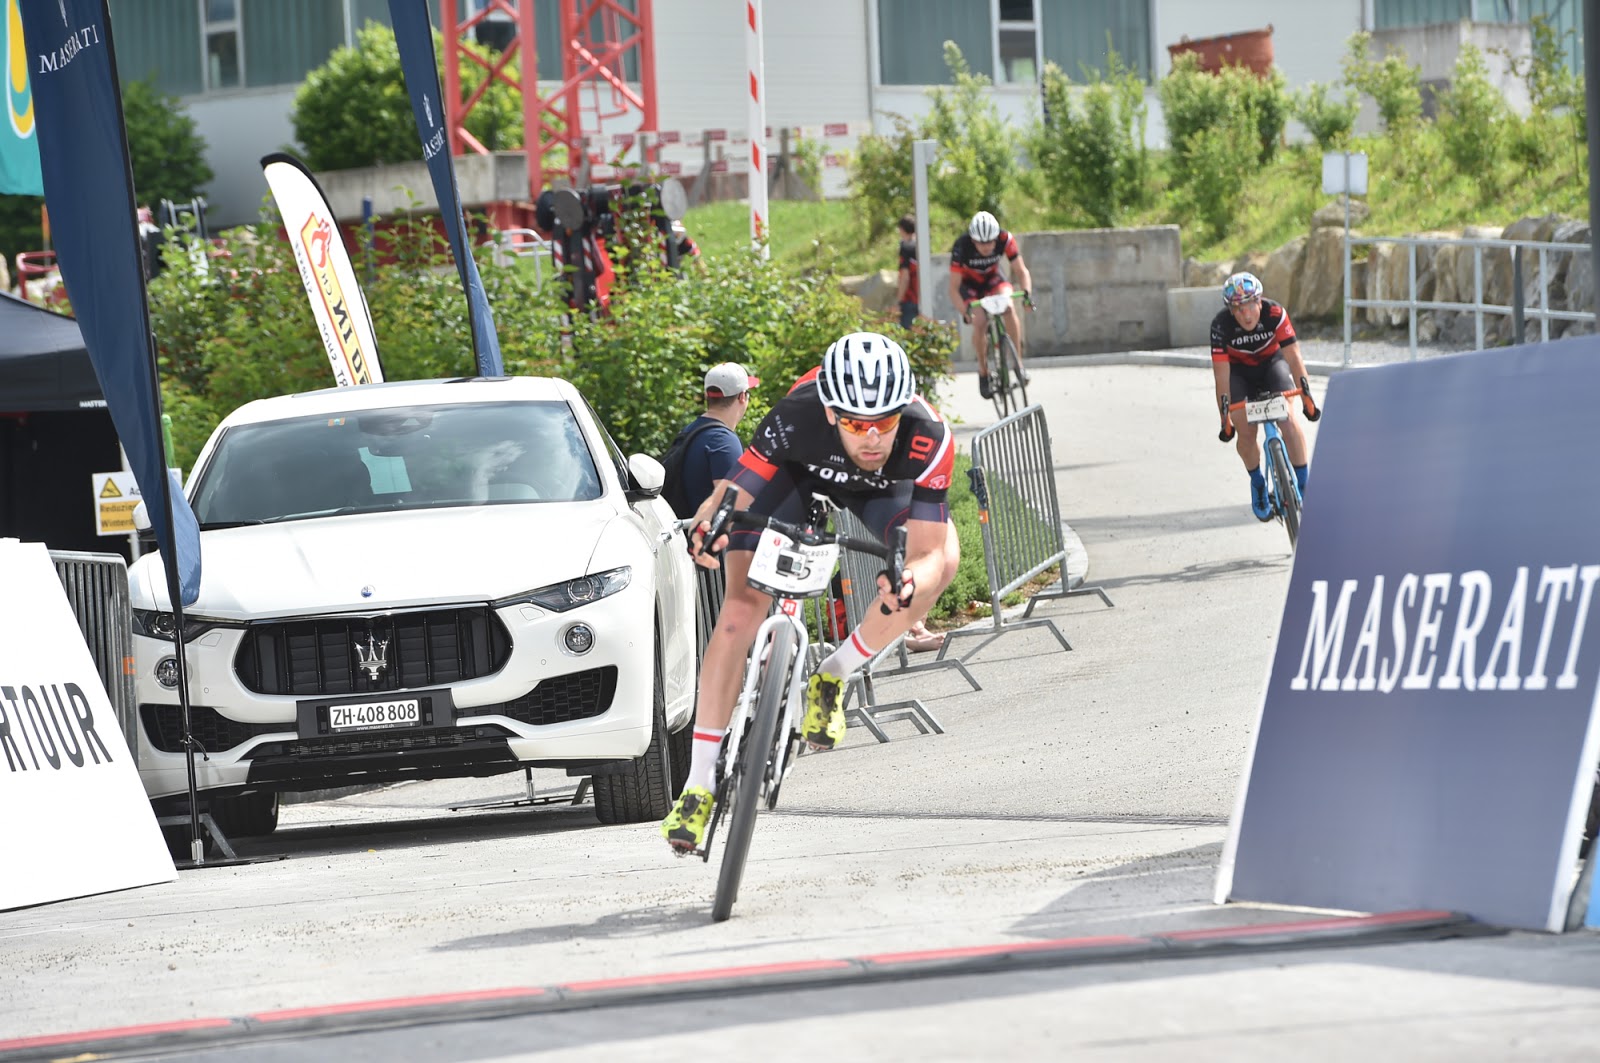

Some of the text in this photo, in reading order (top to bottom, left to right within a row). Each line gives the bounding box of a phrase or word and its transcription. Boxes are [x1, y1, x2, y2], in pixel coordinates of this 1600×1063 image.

[39, 24, 100, 74] MASERATI
[1231, 331, 1274, 346] TORTOUR
[908, 435, 935, 461] 10
[1290, 563, 1600, 694] MASERATI
[0, 682, 114, 772] RTOUR
